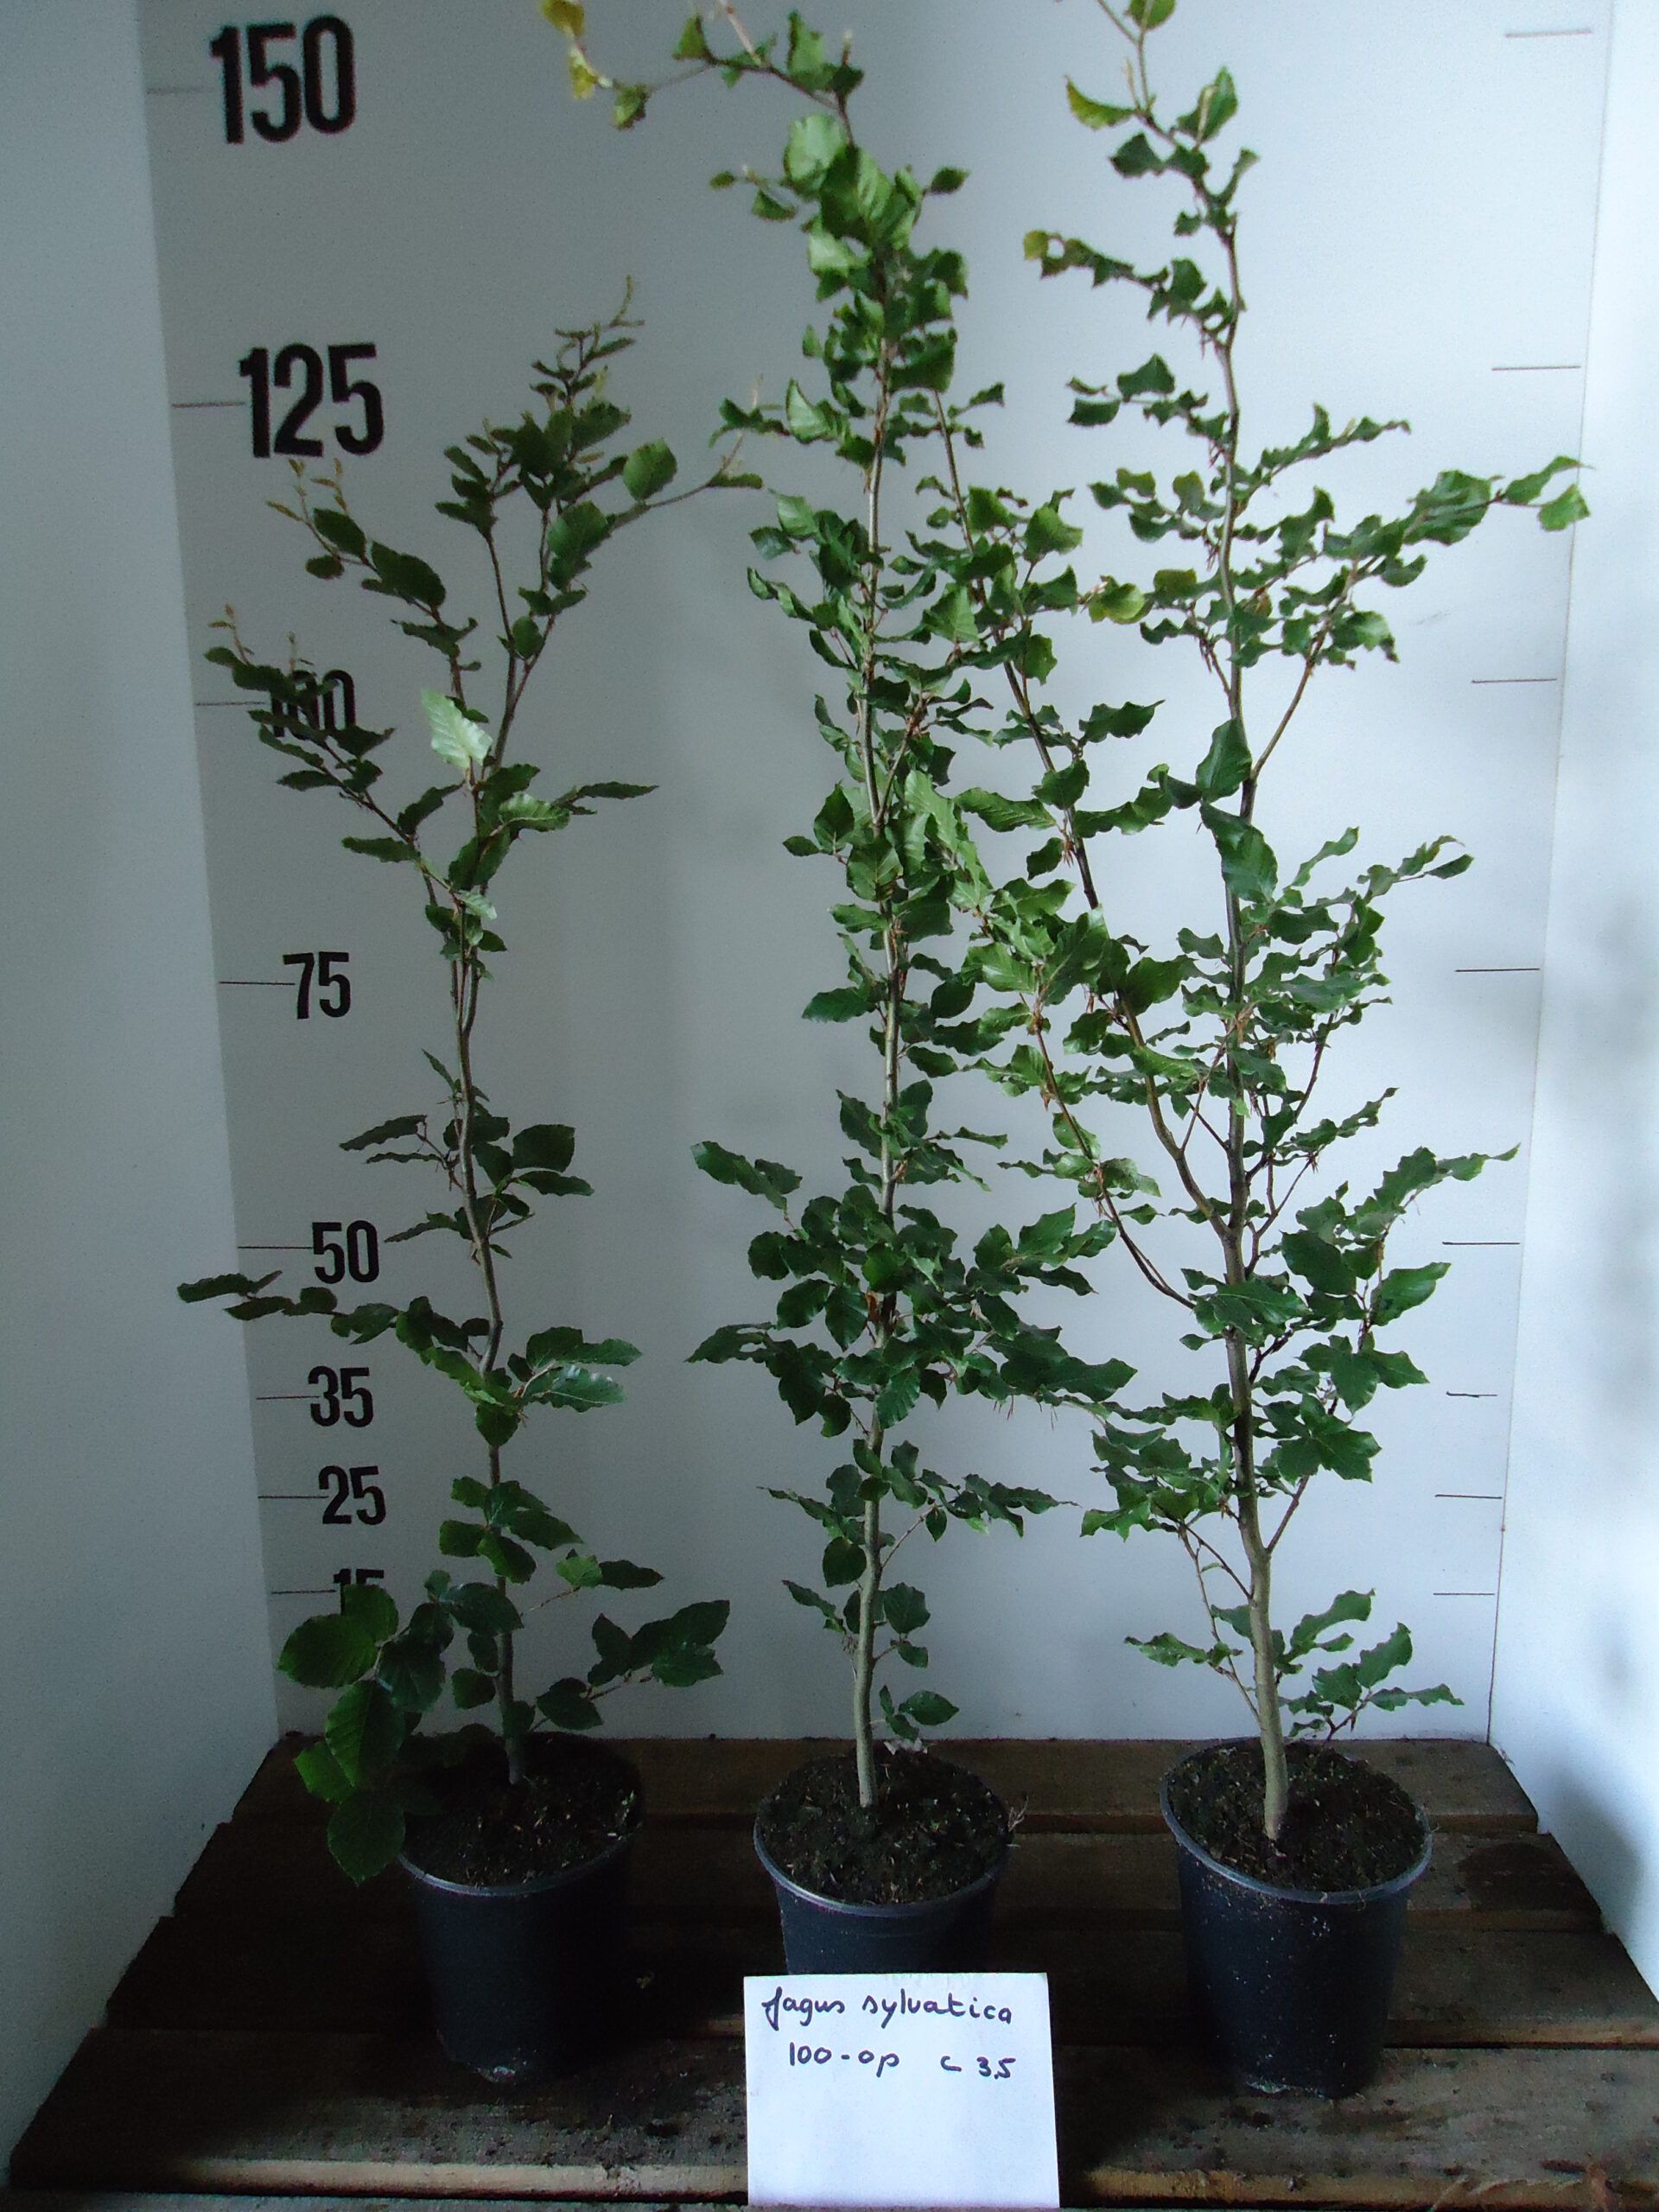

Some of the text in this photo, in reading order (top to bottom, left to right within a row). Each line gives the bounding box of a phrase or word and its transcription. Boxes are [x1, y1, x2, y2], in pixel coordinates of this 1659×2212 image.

[209, 14, 356, 144] 150
[238, 342, 385, 459] 125
[283, 950, 352, 1020] 75
[311, 1219, 380, 1284] 50
[308, 1365, 375, 1428] 35
[318, 1465, 386, 1526] 25
[861, 1987, 1012, 2029] sylvatica
